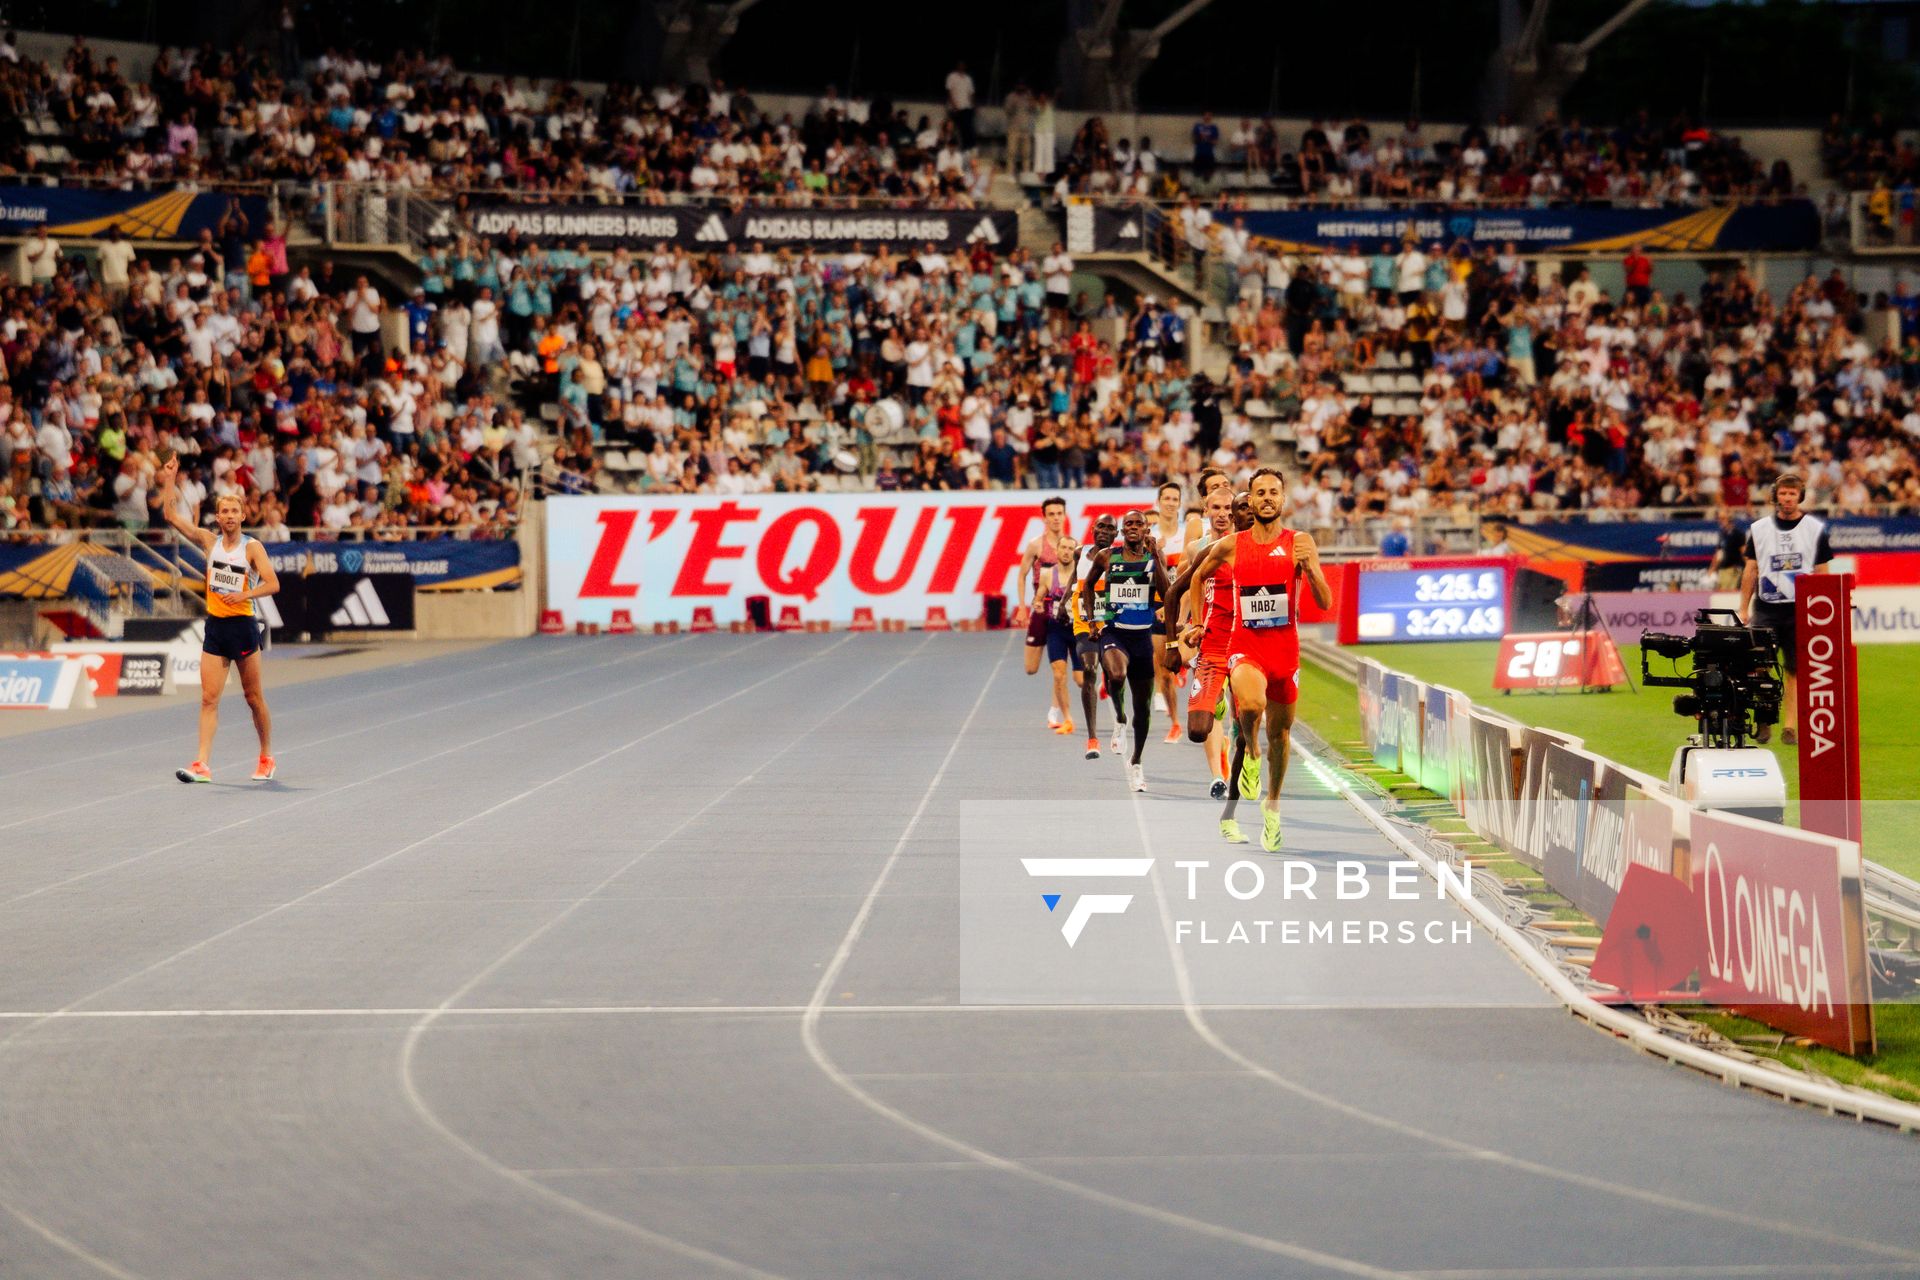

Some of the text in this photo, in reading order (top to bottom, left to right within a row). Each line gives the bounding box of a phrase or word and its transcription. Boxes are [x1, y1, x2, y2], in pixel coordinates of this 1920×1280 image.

[8, 207, 47, 220] LEAGUE
[477, 214, 678, 238] ADIDAS RUNNERS PARIS
[746, 219, 949, 240] ADIDAS RUNNERS PARIS
[1317, 222, 1378, 237] MEETING
[411, 559, 448, 575] LEAGUE
[214, 572, 240, 586] RUDOLF
[1117, 587, 1141, 598] LAGAT
[1415, 572, 1499, 602] 3:25.5
[1251, 599, 1276, 613] HABZ
[1406, 606, 1502, 637] 3:29.63
[1608, 611, 1676, 627] WORLD
[127, 660, 161, 670] INFO
[127, 669, 161, 678] TALK
[118, 678, 164, 688] SPORT
[1807, 634, 1836, 758] OMEGA
[1735, 874, 1834, 1018] OMEGA
